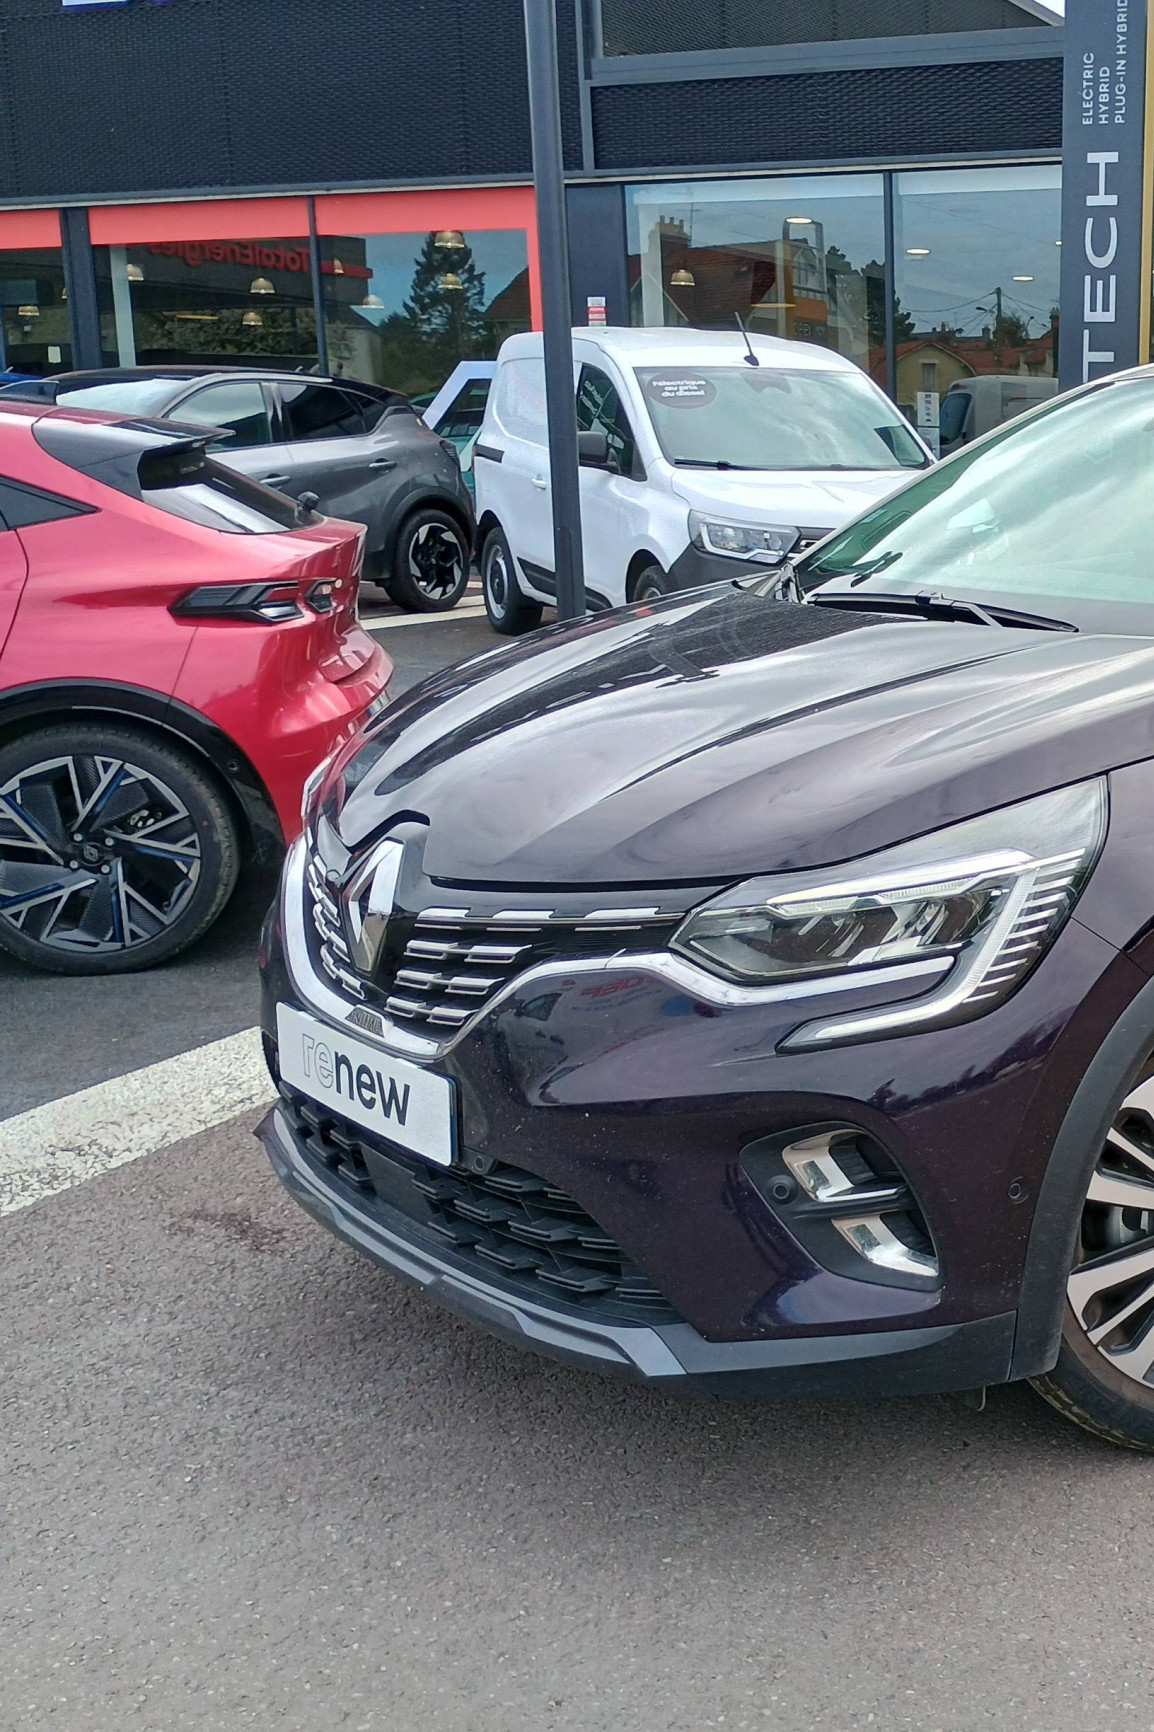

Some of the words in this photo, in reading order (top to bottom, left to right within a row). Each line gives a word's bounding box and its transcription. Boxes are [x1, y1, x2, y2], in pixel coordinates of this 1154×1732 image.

[1115, 0, 1128, 55] HYBRID
[1082, 52, 1095, 125] ELECTRIC
[1098, 66, 1111, 125] HYBRID
[1114, 59, 1127, 124] PLUG-IN
[1082, 151, 1119, 384] TECH
[301, 1032, 411, 1127] renew
